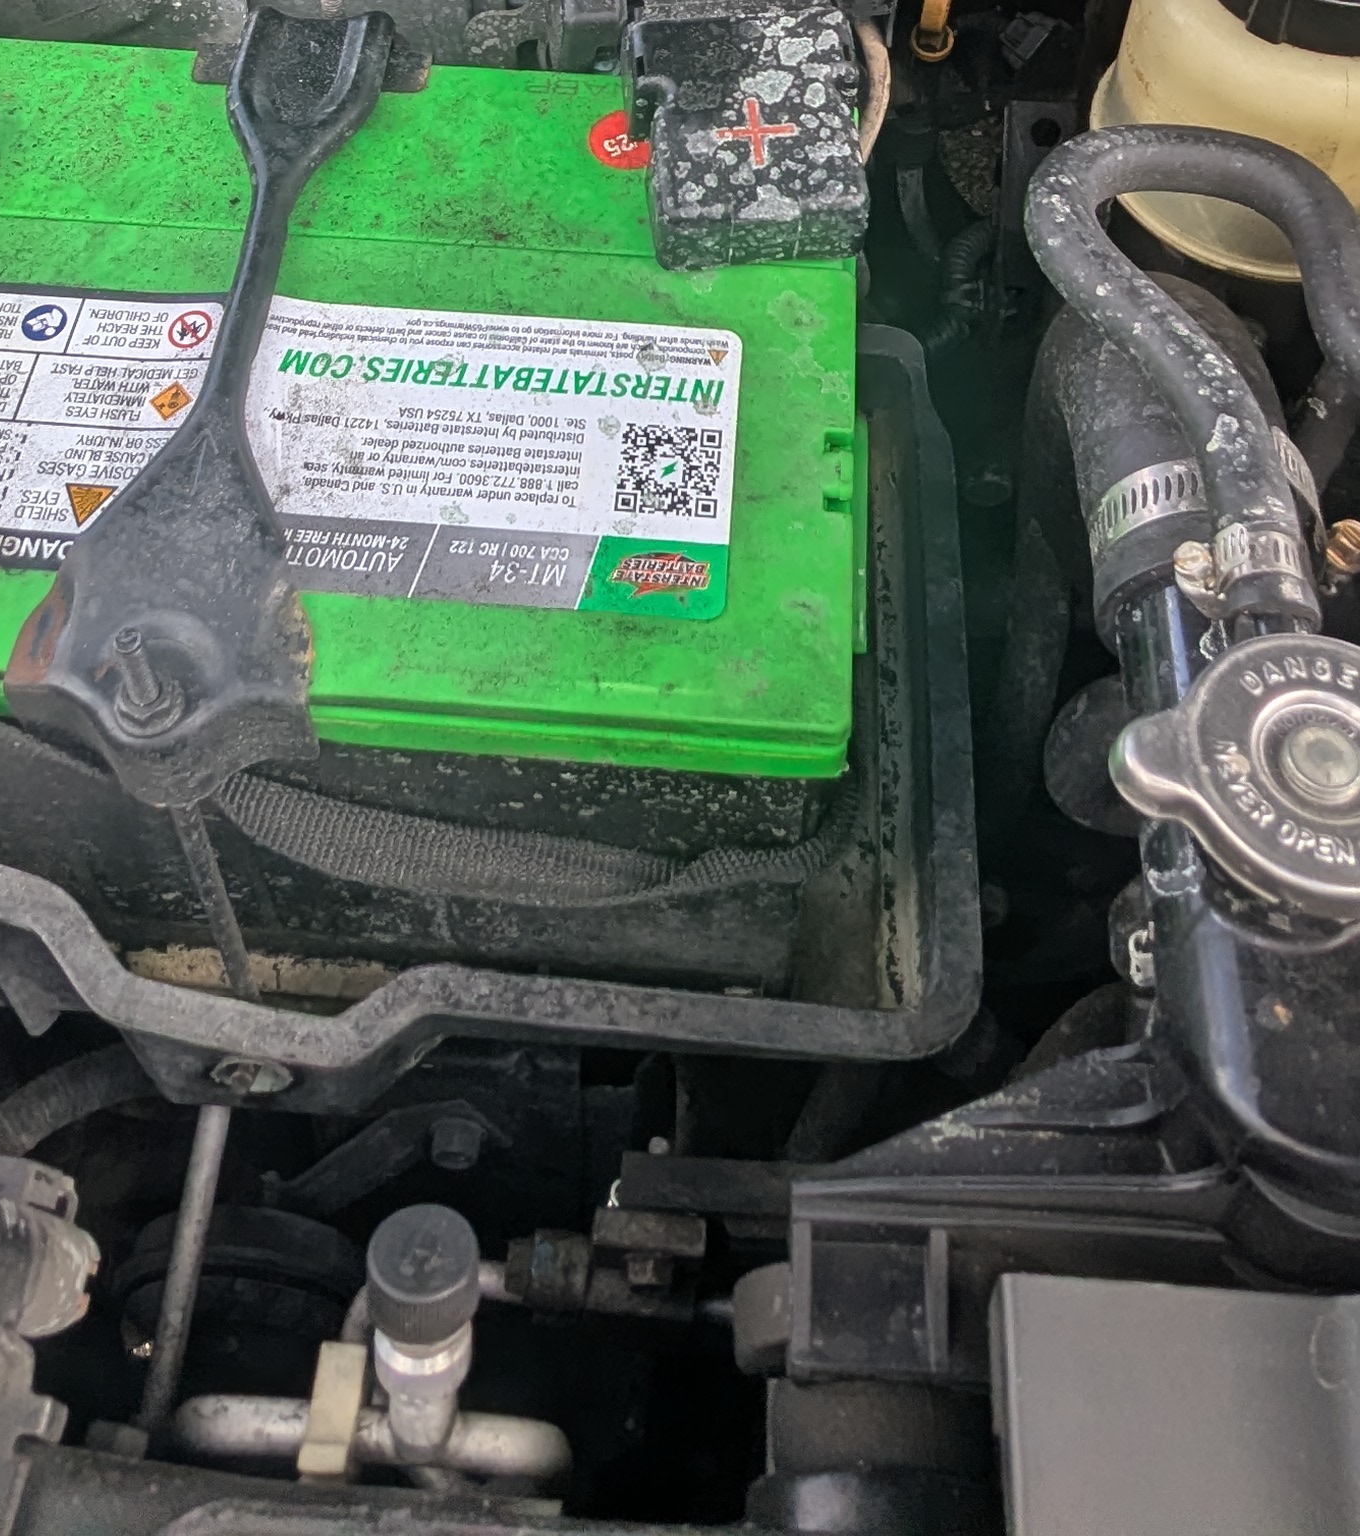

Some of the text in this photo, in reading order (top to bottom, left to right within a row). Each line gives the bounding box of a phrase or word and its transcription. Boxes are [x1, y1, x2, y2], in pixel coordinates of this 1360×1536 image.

[88, 307, 168, 322] OF CHILDREN.
[96, 321, 163, 335] THE REACH
[82, 333, 160, 349] KEEP OUT OF
[50, 362, 198, 381] GET MEDICAL HELP FAST.
[278, 348, 725, 405] INTERSTATEBATTERIES.COM
[71, 377, 149, 393] WITH WATER.
[63, 391, 146, 407] IMMEDIATELY
[65, 405, 140, 421] FLUSH EYES
[304, 414, 340, 427] Dallas
[398, 406, 586, 429] Ste. 1000, Dallas, TX 75254 USA
[344, 417, 378, 429] 14221
[383, 418, 439, 434] Batteries,
[442, 424, 499, 438] Interstate
[501, 425, 516, 440] by
[518, 429, 584, 444] Distributed
[75, 433, 169, 450] ESS OR INJURY.
[360, 436, 582, 462] Interstate Batteries authorized dealer.
[102, 450, 145, 464] CAUSE
[350, 451, 580, 478] interstatebatteries.com/warranty or an
[36, 460, 86, 476] GASES
[387, 467, 428, 482] limited
[432, 471, 452, 483] For
[456, 472, 552, 490] 1.888.772.3600.
[301, 475, 576, 507] To replace under warranty in U.S. and Canada,
[556, 480, 578, 492] call
[19, 489, 59, 505] EYES.
[13, 504, 68, 521] SHIELD
[295, 527, 330, 544] FREE
[332, 530, 409, 550] 24-MONTH
[285, 543, 403, 573] AUTOMOTI
[449, 539, 569, 561] CCA 700 RC 122
[487, 558, 566, 586] MT-34
[620, 556, 709, 575] BATTERIES
[608, 568, 709, 589] INTERSTATE
[1276, 820, 1357, 866] OPEN
